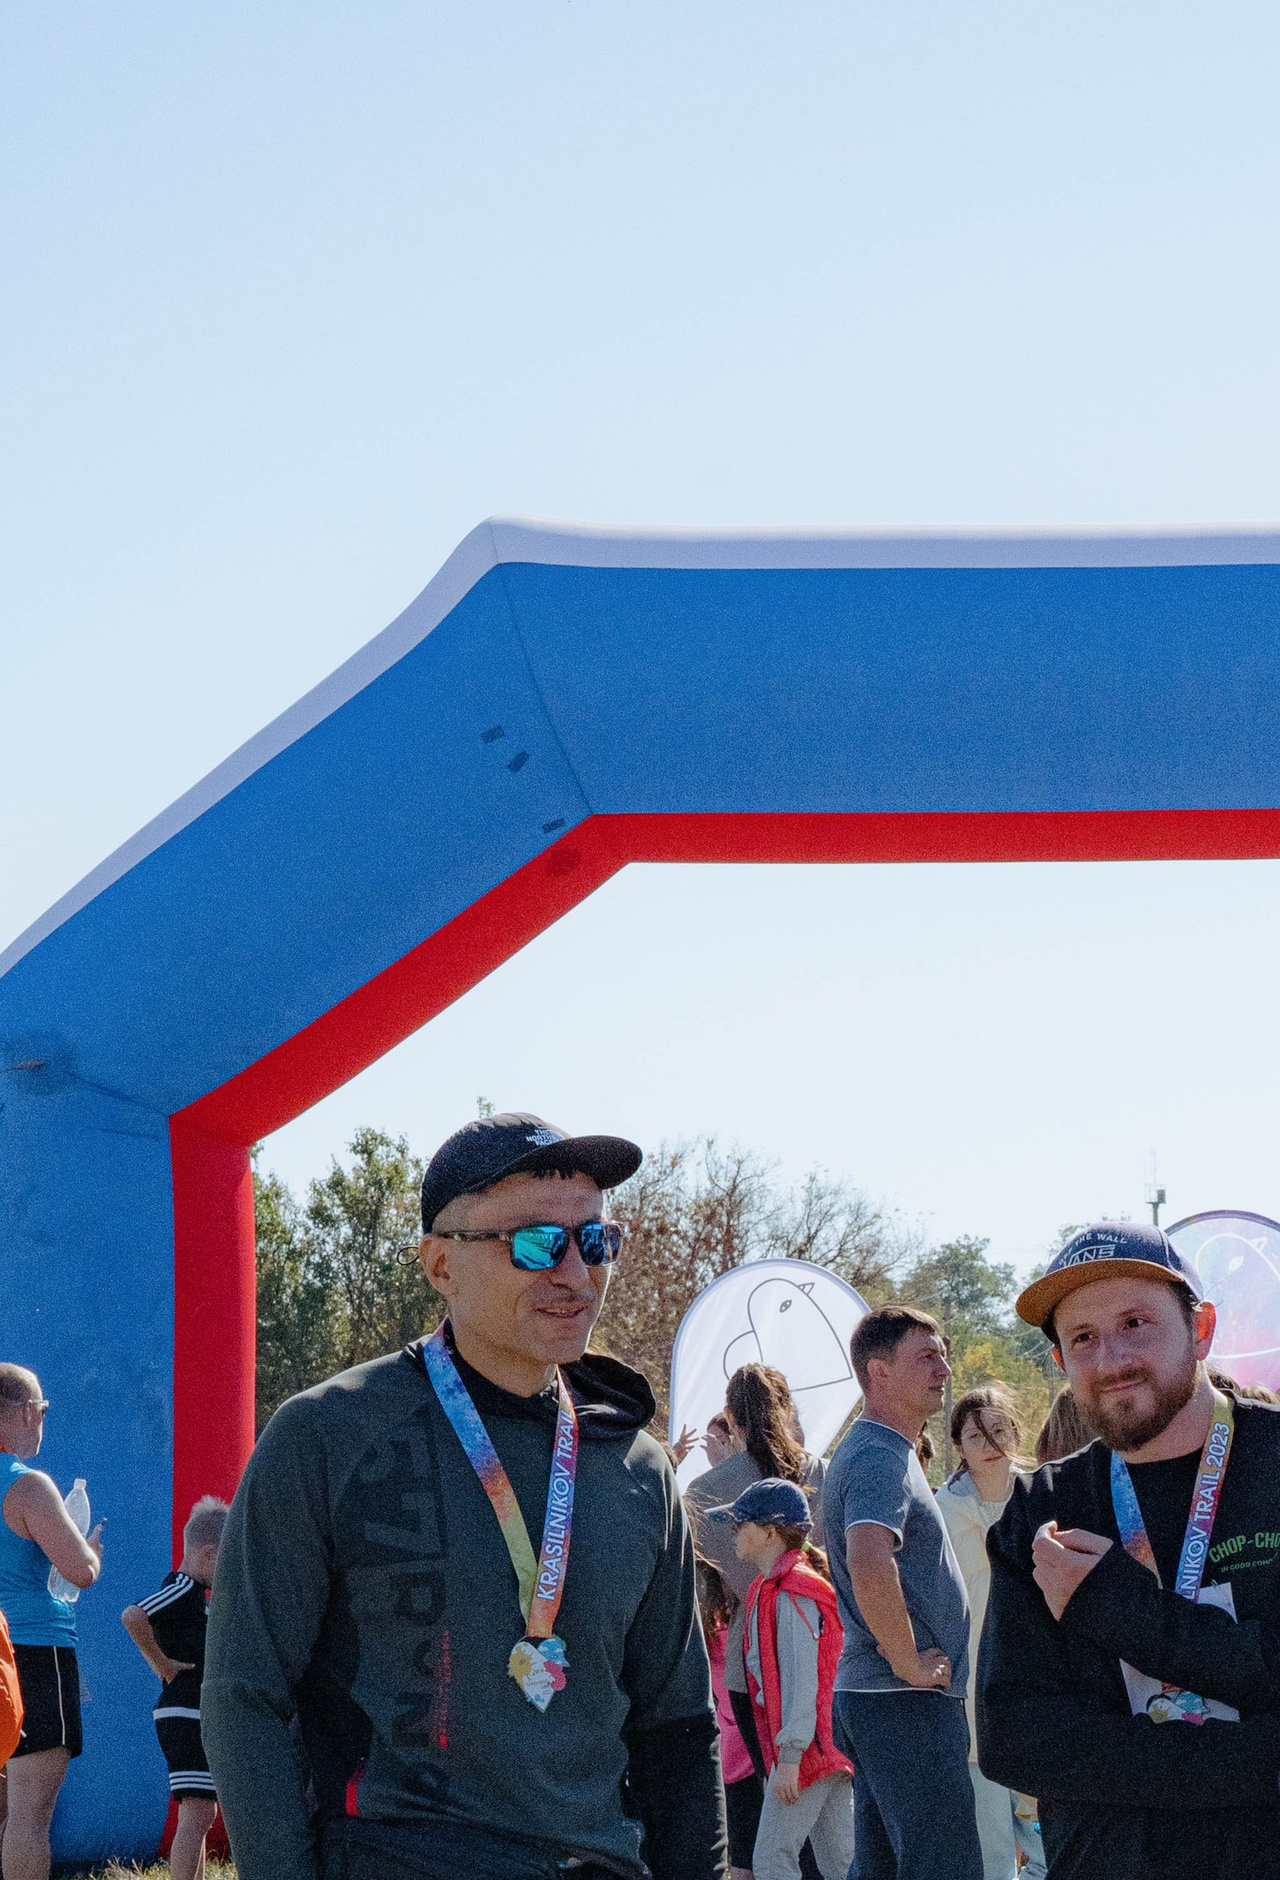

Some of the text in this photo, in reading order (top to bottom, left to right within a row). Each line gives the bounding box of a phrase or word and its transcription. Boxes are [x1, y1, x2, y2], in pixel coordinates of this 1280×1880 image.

[1063, 1244, 1117, 1267] VANS
[1075, 1233, 1092, 1246] THE
[1097, 1233, 1128, 1244] WALL
[1206, 1422, 1231, 1468] 2023
[537, 1461, 571, 1601] KRASILNIKOV
[557, 1409, 575, 1459] TRAIL
[1194, 1471, 1221, 1522] TRAIL
[1230, 1561, 1251, 1570] GOOD
